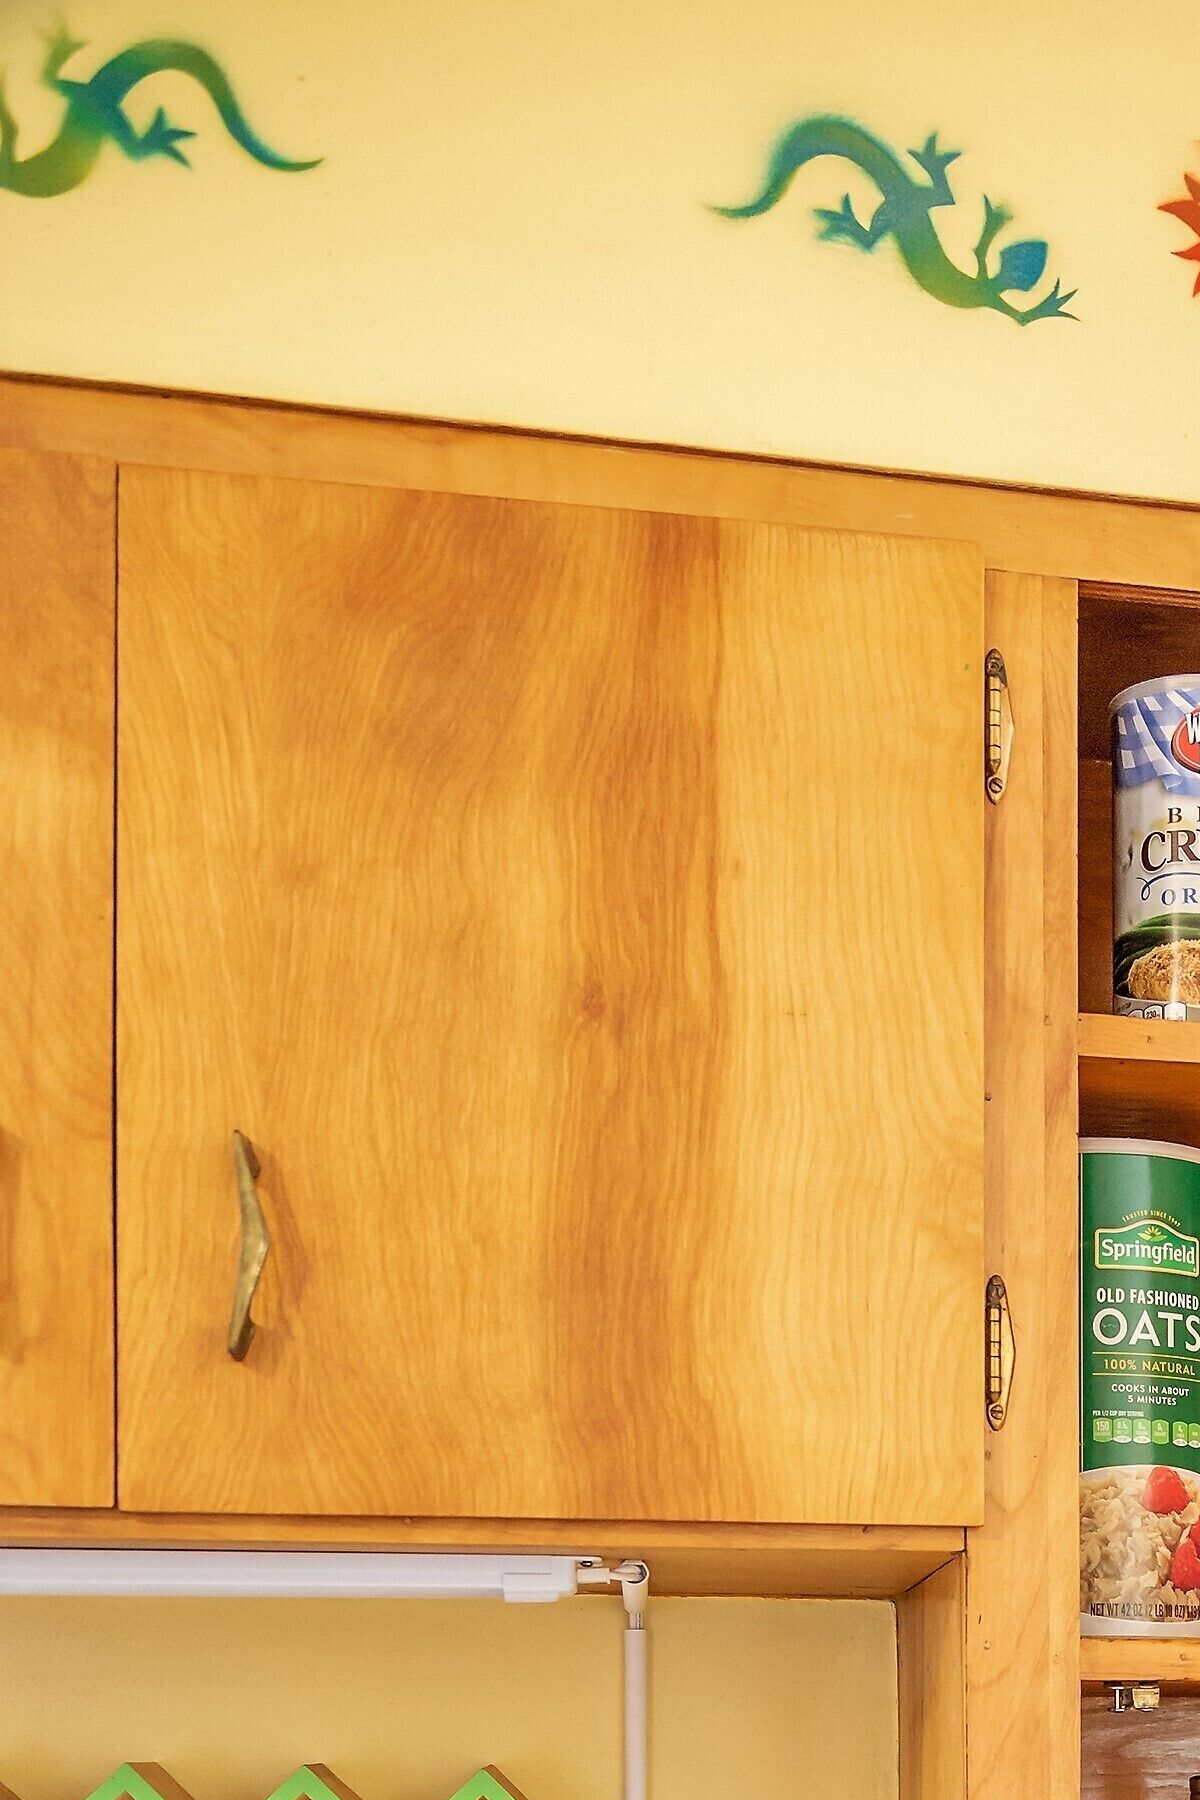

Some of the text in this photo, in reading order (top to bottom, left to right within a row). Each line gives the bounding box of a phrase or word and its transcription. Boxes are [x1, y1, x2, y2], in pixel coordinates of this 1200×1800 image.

[1150, 1209, 1168, 1219] SINCE
[1101, 1238, 1196, 1265] Springfield
[1096, 1287, 1199, 1311] OLD FASHIONED
[1104, 1359, 1196, 1376] 100% NATURAL
[1111, 1383, 1189, 1397] COOKS IN ABOUT
[1127, 1395, 1177, 1406] 5 MINUTES
[1090, 1603, 1104, 1617] NET
[1106, 1603, 1119, 1617] WT
[1121, 1603, 1131, 1617] 42
[1133, 1603, 1143, 1617] OZ
[1154, 1604, 1164, 1618] LB
